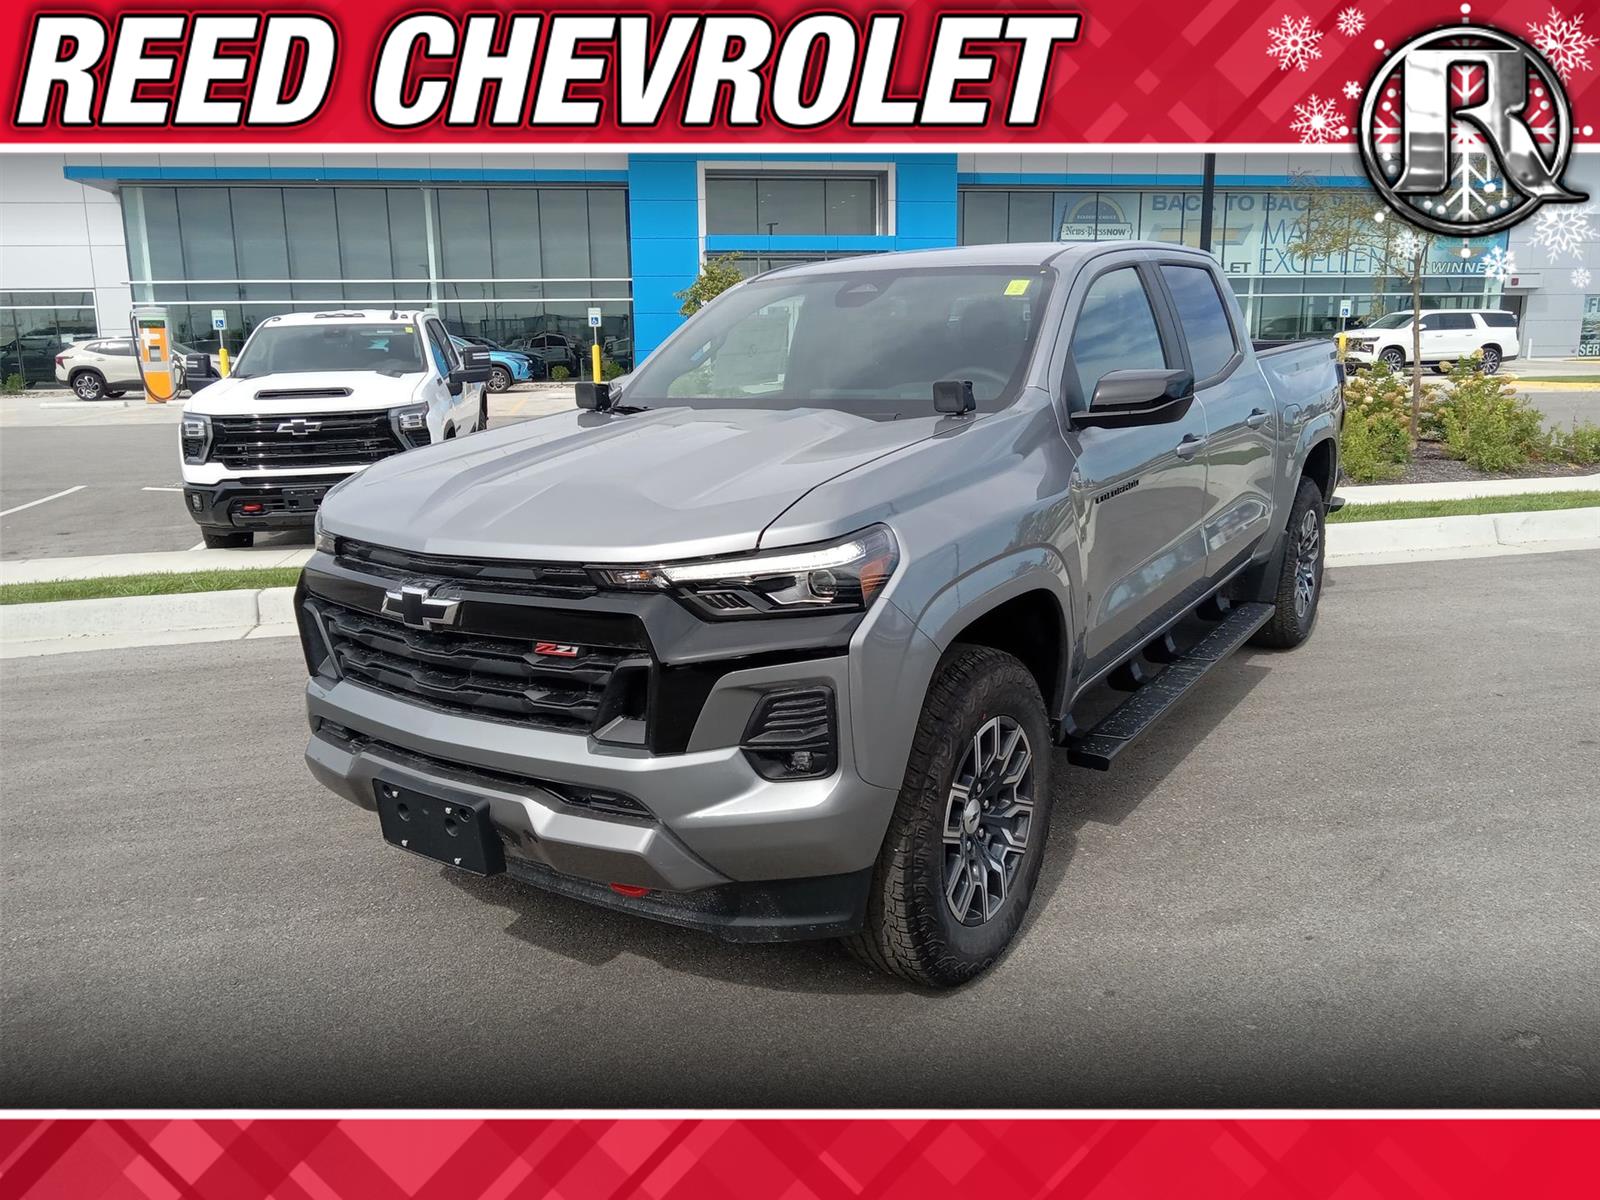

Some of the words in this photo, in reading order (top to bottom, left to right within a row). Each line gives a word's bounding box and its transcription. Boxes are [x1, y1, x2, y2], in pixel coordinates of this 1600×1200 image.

[1152, 195, 1216, 211] BAC
[1226, 195, 1255, 211] TO
[1259, 248, 1417, 273] EXCELLENE
[535, 642, 579, 657] Z71
